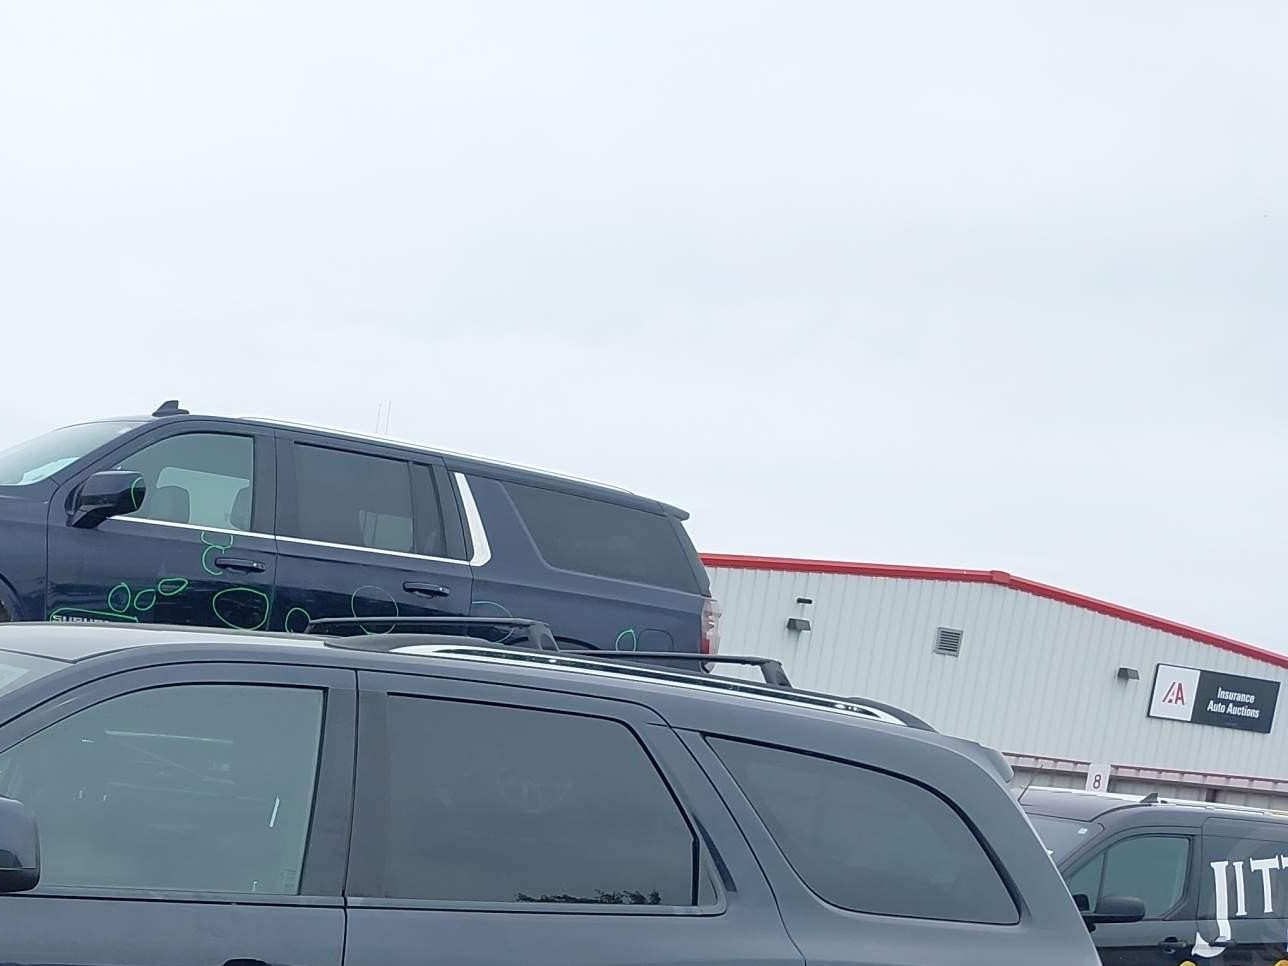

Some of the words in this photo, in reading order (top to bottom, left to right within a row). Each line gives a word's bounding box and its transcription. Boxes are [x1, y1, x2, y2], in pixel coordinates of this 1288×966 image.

[1217, 687, 1255, 703] Insurance
[1207, 700, 1225, 713] Auto
[1226, 703, 1260, 718] Auctions
[1093, 774, 1102, 789] 8
[1191, 854, 1288, 958] JIT
